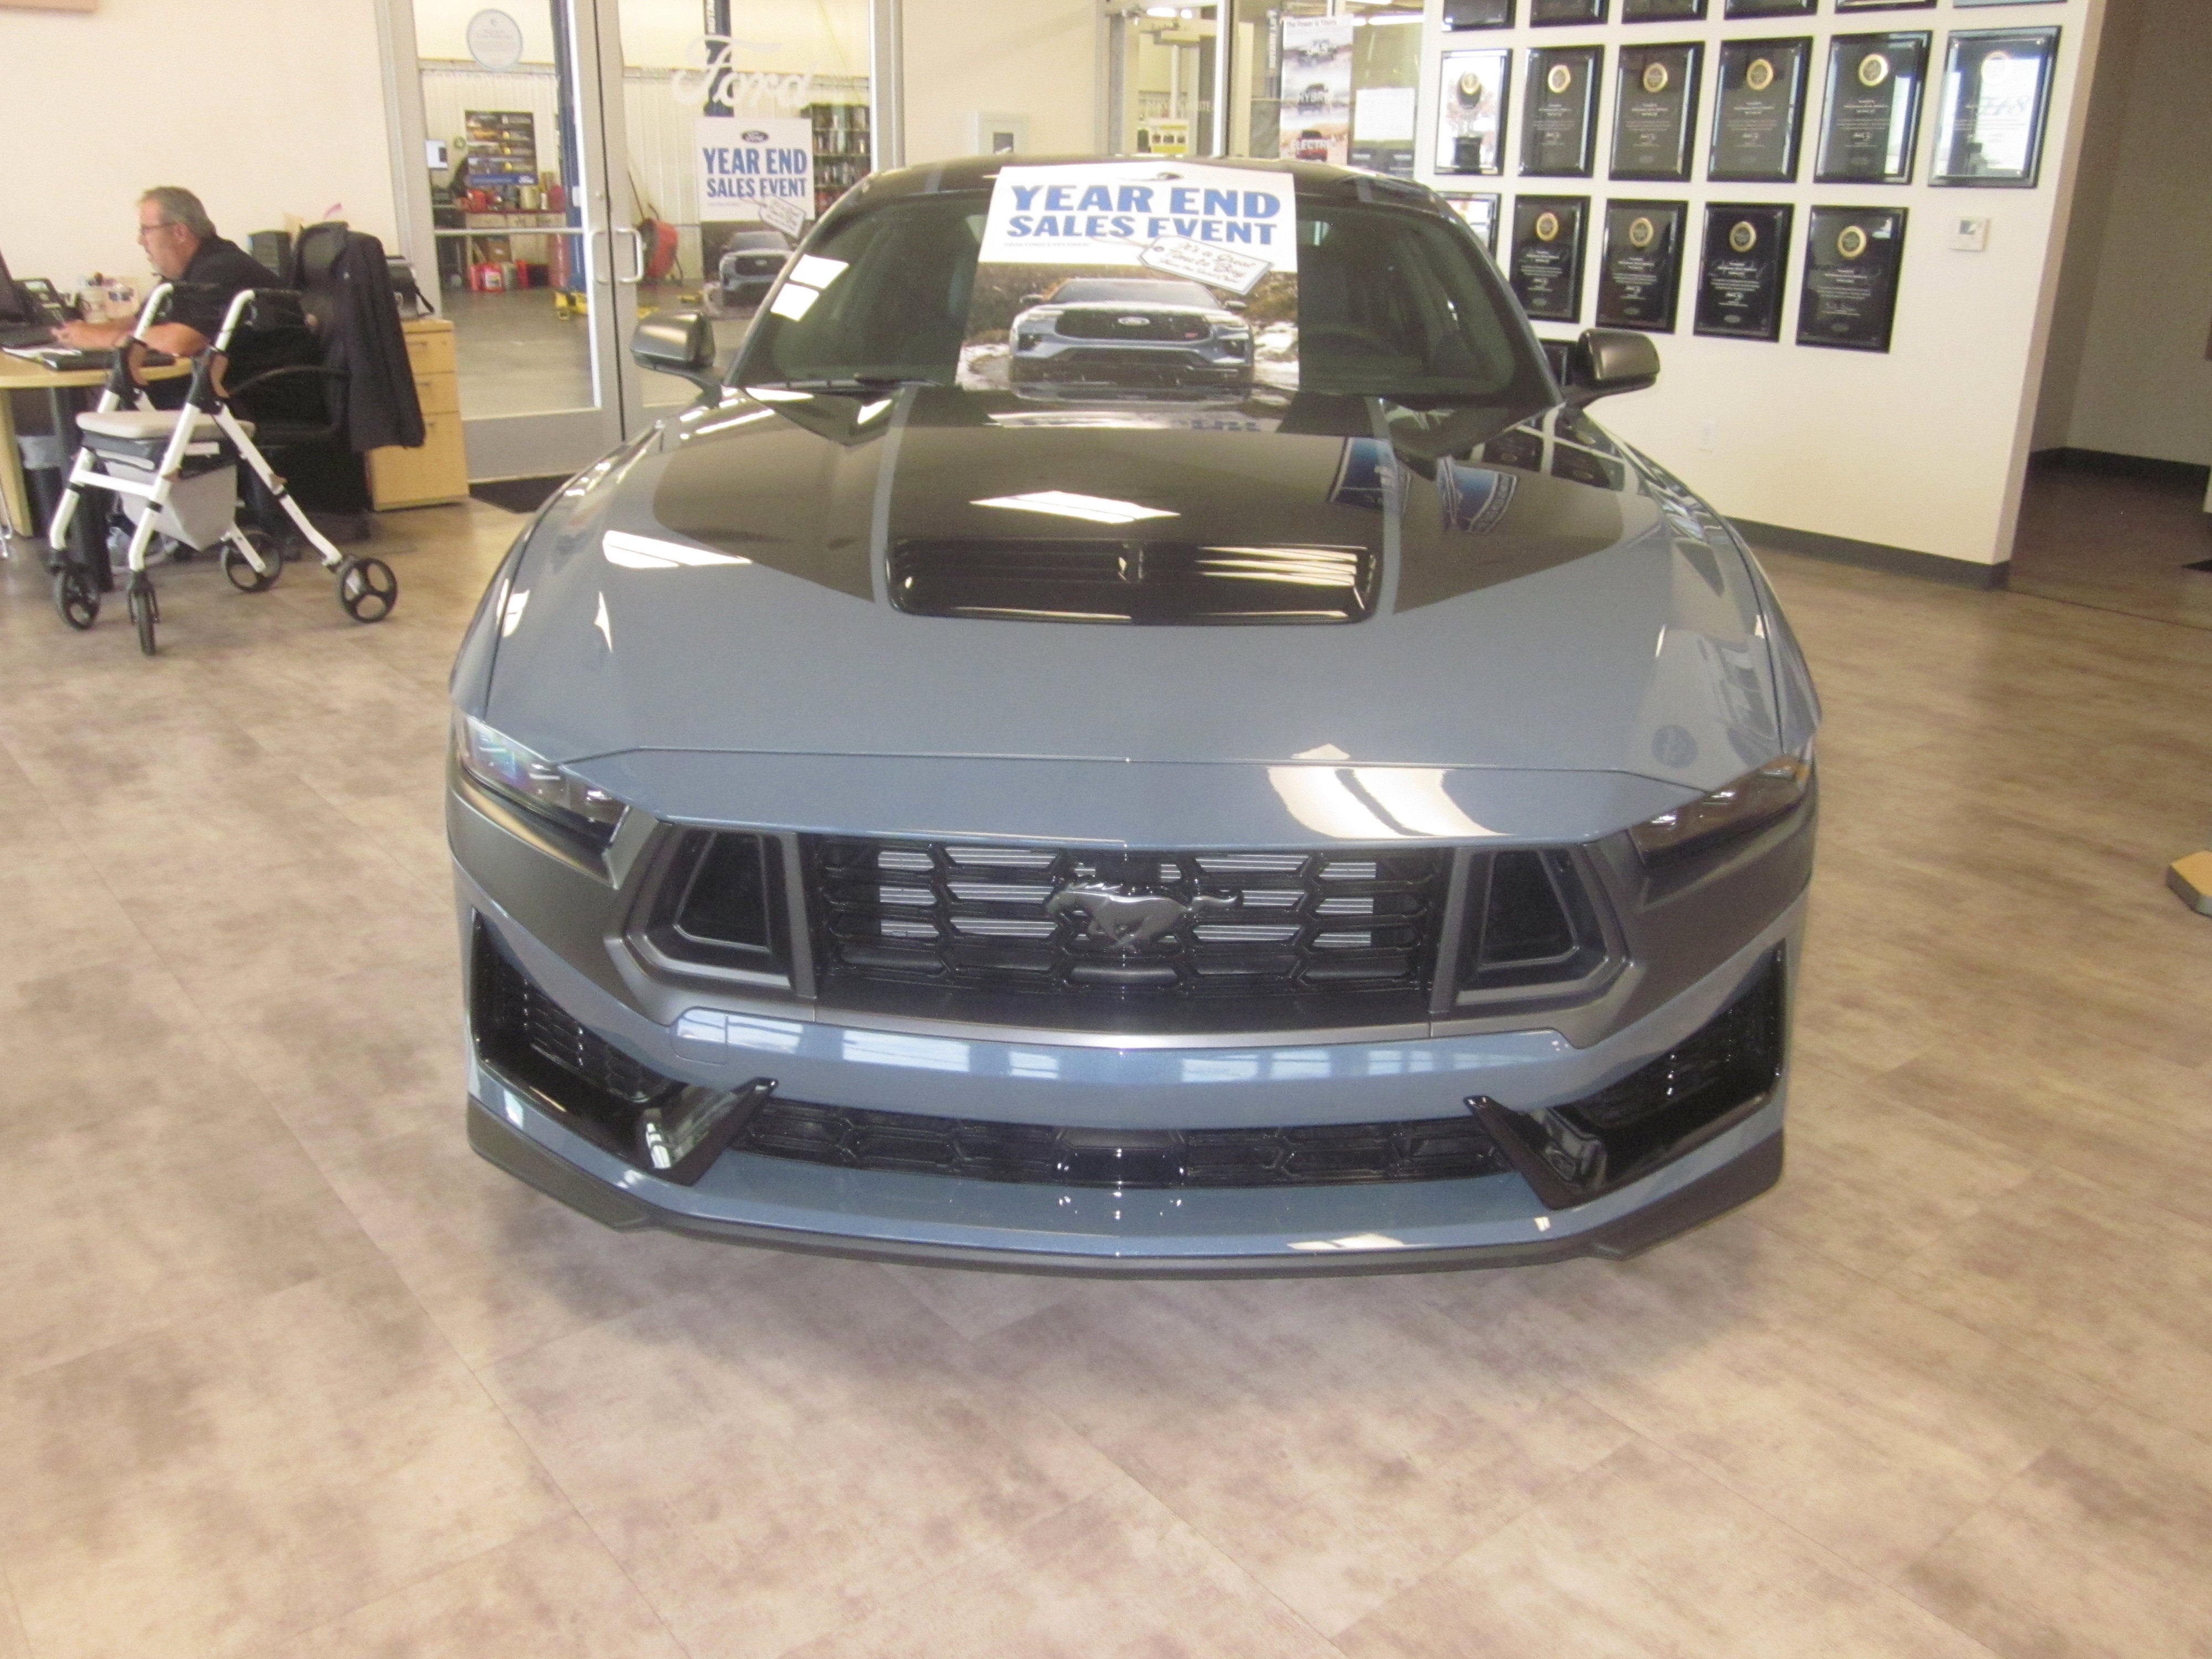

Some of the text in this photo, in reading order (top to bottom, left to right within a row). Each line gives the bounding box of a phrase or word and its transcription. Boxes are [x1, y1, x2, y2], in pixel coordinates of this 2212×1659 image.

[672, 34, 819, 108] Ford
[702, 148, 807, 174] YEAR END
[707, 178, 807, 197] SALES EVENT
[1011, 184, 1280, 219] YEAR END
[1006, 215, 1277, 245] SALES EVENT
